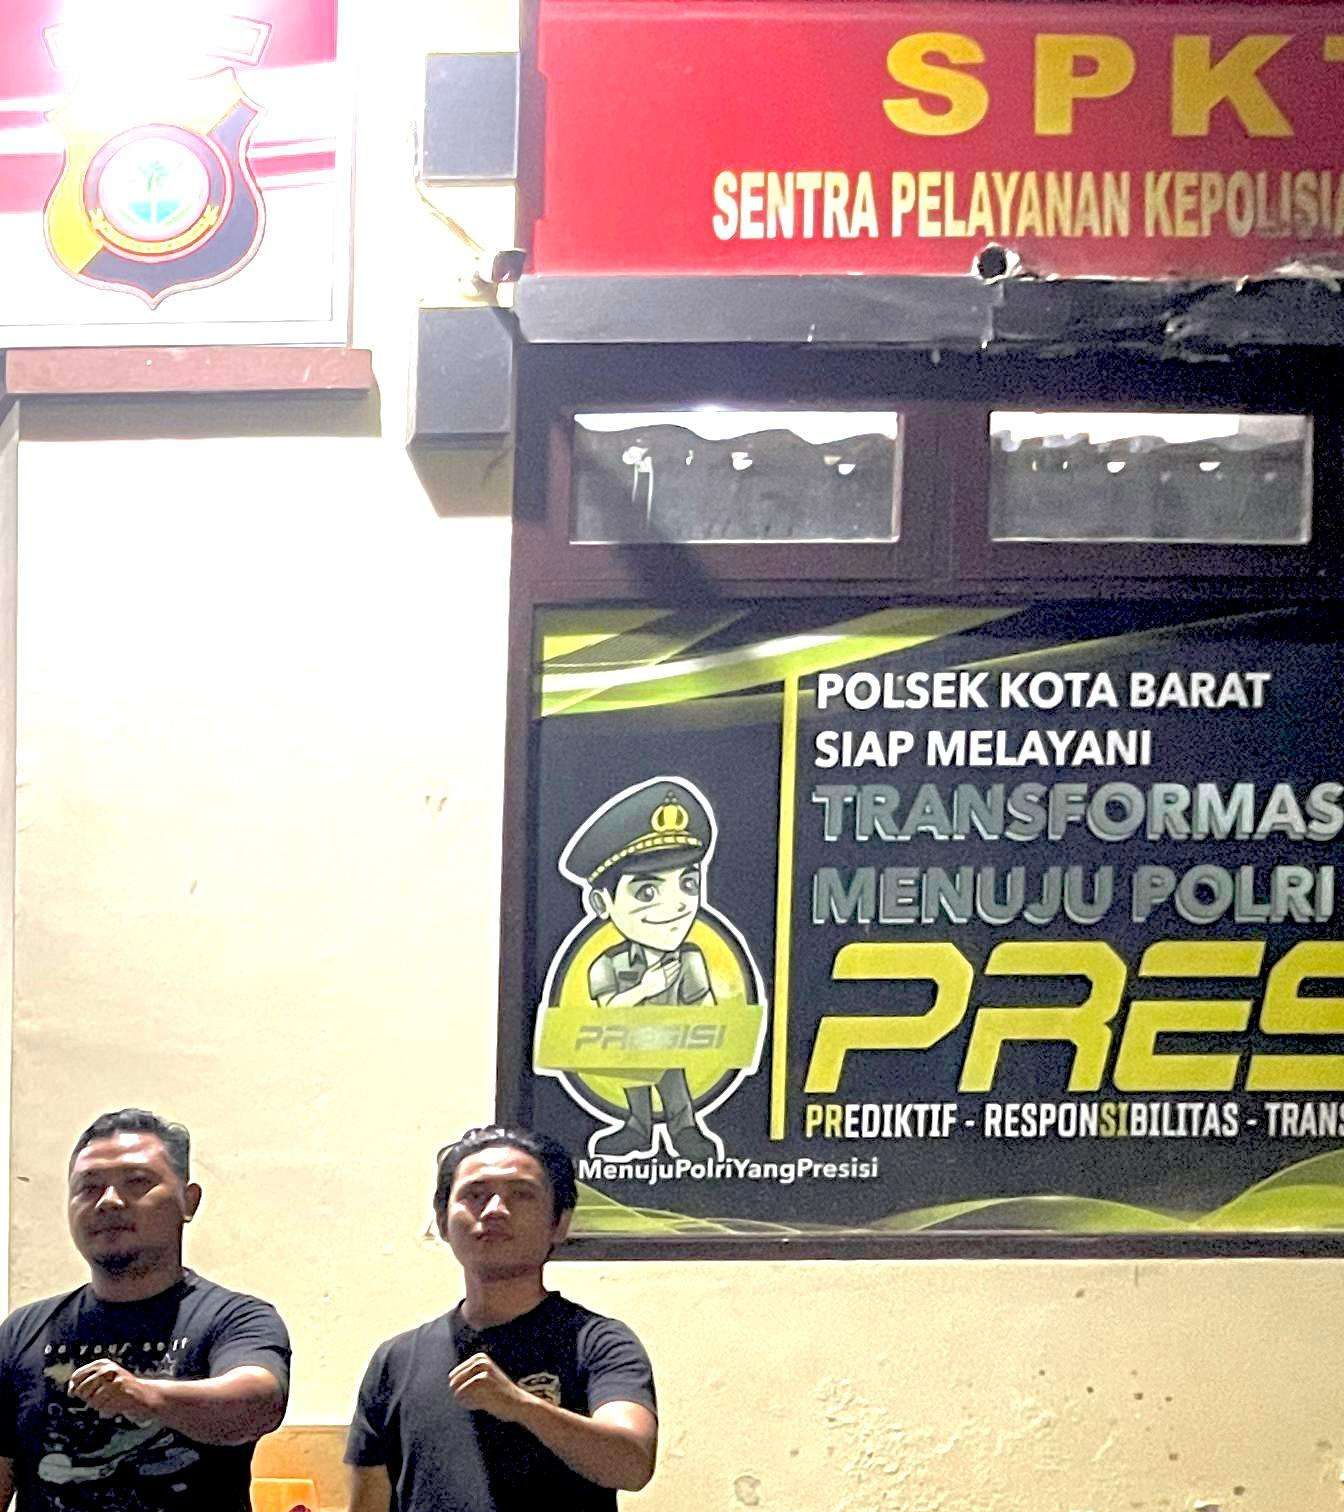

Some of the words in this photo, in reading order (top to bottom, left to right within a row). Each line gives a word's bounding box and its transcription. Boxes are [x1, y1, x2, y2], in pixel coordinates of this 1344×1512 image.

[884, 32, 1344, 138] SPK
[712, 169, 879, 239] SENTRA
[892, 169, 1131, 239] PELAYANAN
[817, 671, 989, 710] POLSEK
[1001, 671, 1119, 709] KOTA
[1130, 671, 1272, 709] BARAT
[814, 729, 914, 768] SIAP
[926, 728, 1152, 767] MELAYANI
[812, 781, 1344, 841] TRANSFORMAS
[812, 864, 1113, 924] MENUJU
[1132, 863, 1336, 924] POLRI
[805, 1102, 958, 1138] PREDIKTIF
[984, 1101, 1239, 1138] RESPONSIBILITAS
[577, 1157, 879, 1184] MenujuPolriYangPresisi
